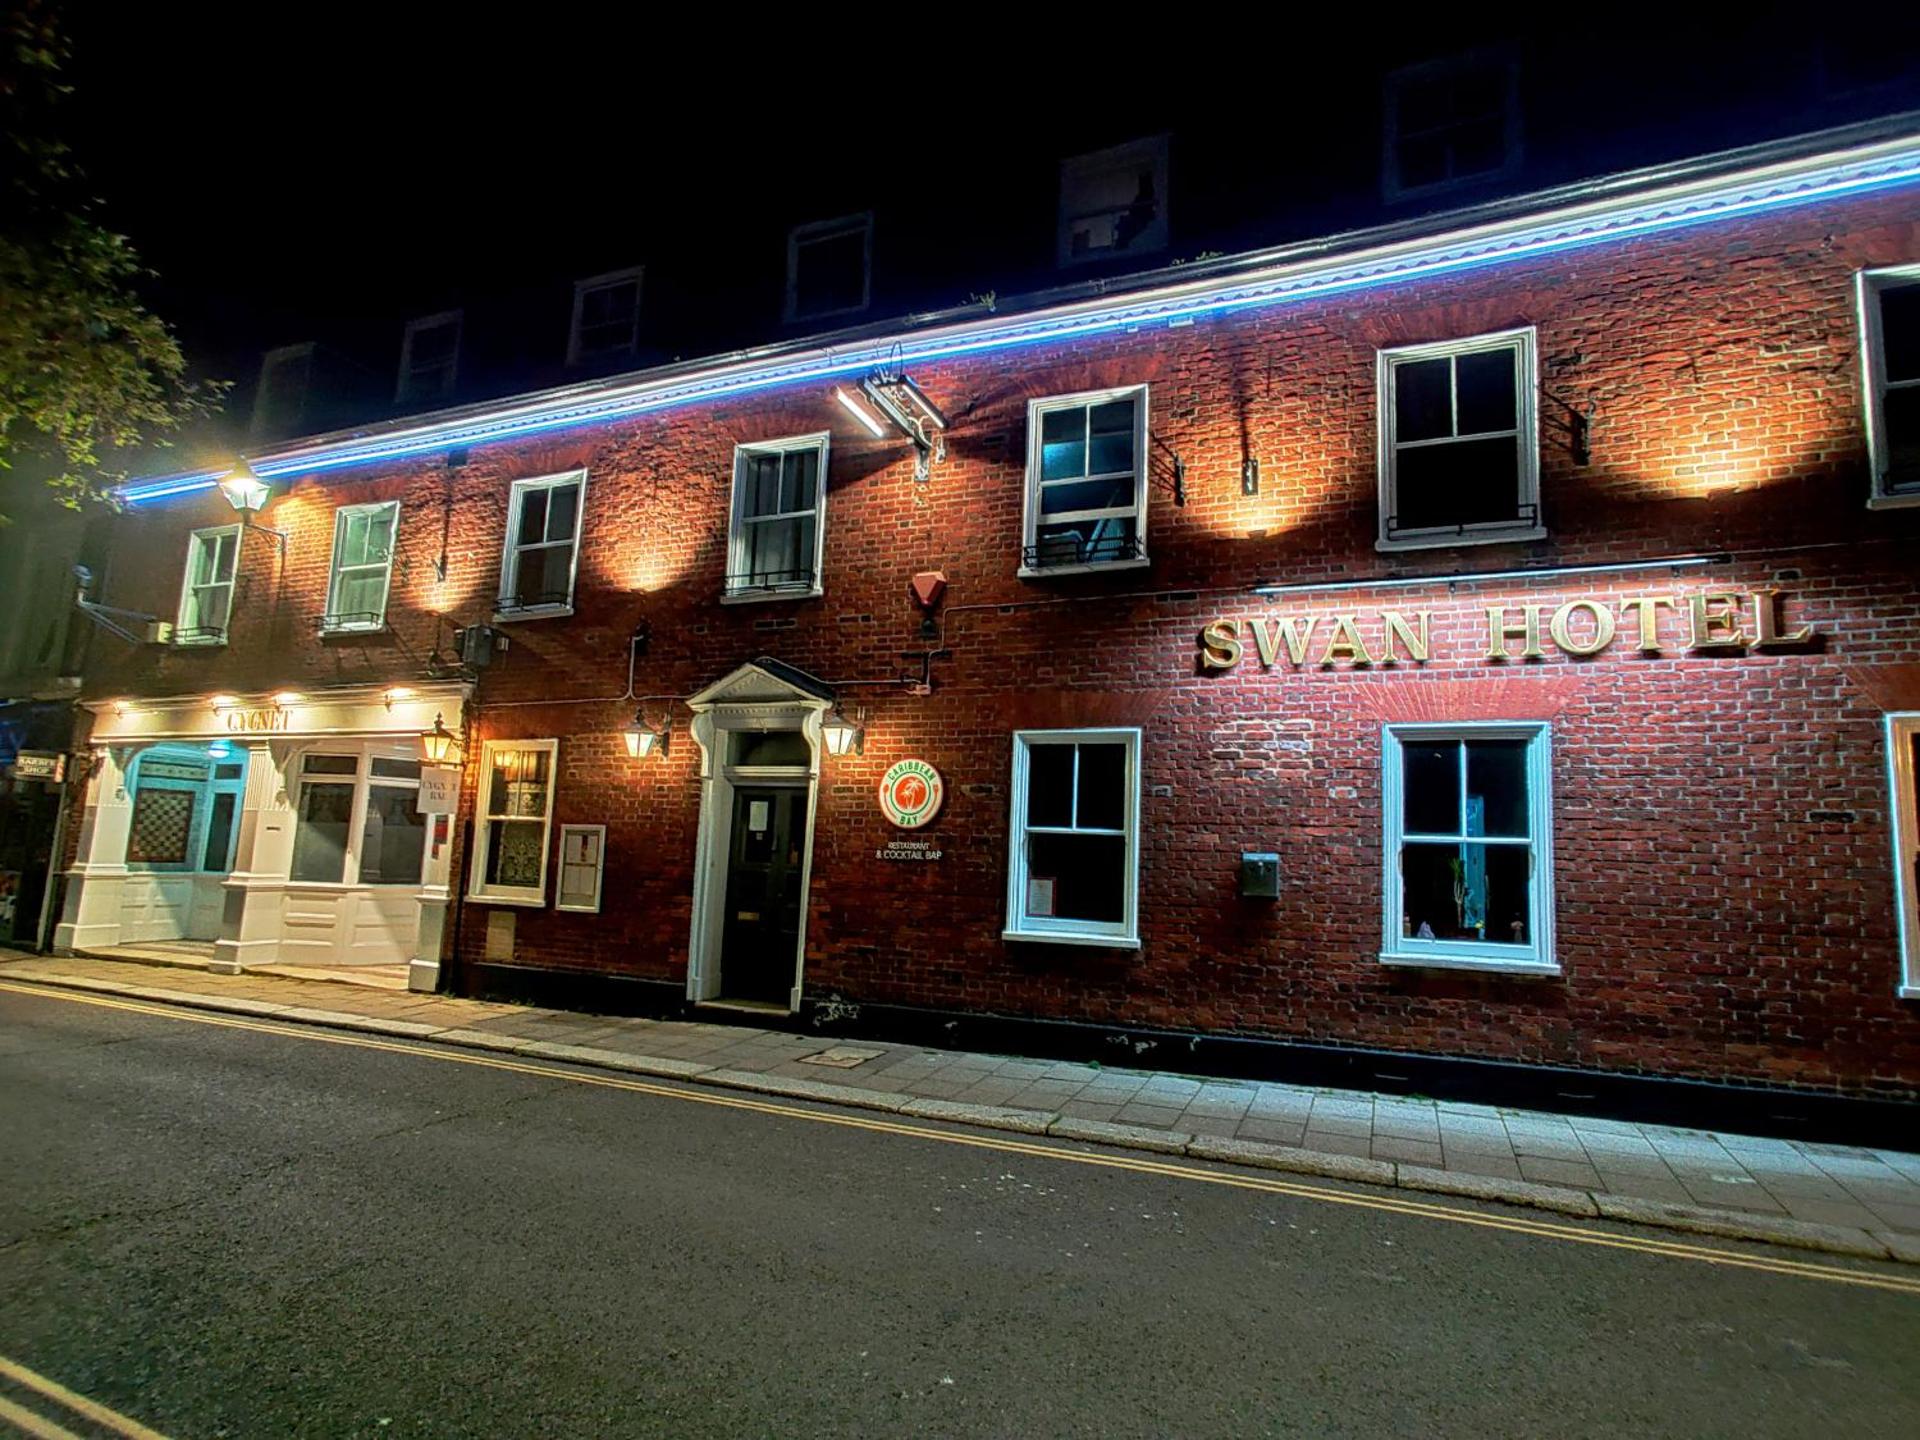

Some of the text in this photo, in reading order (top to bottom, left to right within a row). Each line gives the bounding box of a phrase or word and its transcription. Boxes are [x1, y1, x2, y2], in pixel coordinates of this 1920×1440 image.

[1202, 588, 1813, 668] SWAN HOTEL
[227, 709, 293, 732] CYGNET
[888, 761, 936, 780] CARIBBEAN
[900, 815, 919, 825] BAY
[875, 850, 942, 860] & COCKTAIL BAR
